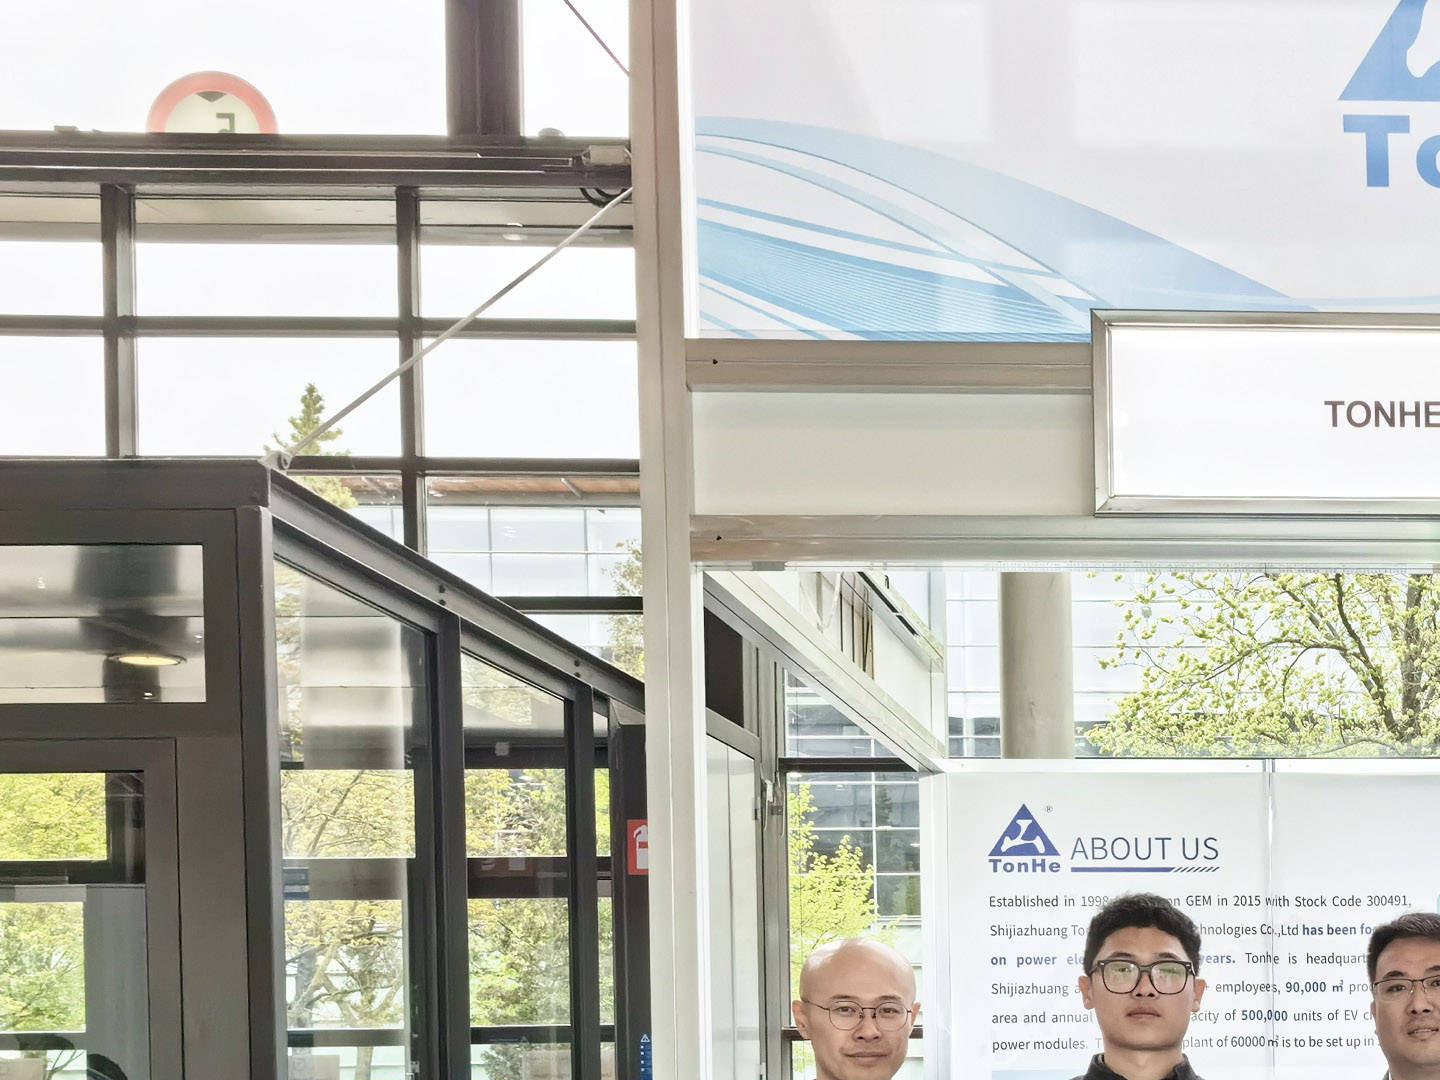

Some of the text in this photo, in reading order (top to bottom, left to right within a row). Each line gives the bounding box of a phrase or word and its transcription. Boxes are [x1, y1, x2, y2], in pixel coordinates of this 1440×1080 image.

[1071, 837, 1219, 860] ABOUT US
[988, 858, 1061, 873] TonHe
[989, 895, 1059, 907] Established
[1064, 895, 1075, 907] in
[1186, 895, 1212, 906] GEM
[1217, 895, 1228, 906] in
[1233, 895, 1261, 906] 2015
[1265, 895, 1290, 907] with
[1294, 895, 1327, 907] Stock
[1332, 895, 1362, 907] Code
[1366, 895, 1412, 908] 300491,
[990, 924, 1068, 939] Shijiazhuang
[1196, 923, 1257, 938] hnologies
[1302, 923, 1323, 935] has
[1327, 923, 1357, 935] been
[990, 955, 1007, 965] on
[1016, 955, 1057, 968] power
[1245, 952, 1280, 964] Tonhe
[1288, 953, 1297, 964] is
[1306, 952, 1369, 967] headquart
[991, 983, 1069, 998] Shijiazhuang
[1215, 981, 1281, 995] employees,
[1285, 981, 1326, 995] 90,000
[992, 1013, 1018, 1023] area
[1023, 1012, 1046, 1023] and
[1051, 1011, 1093, 1023] annual
[1191, 1010, 1219, 1023] acity
[1224, 1009, 1236, 1021] of
[1241, 1010, 1288, 1023] 500,000
[1293, 1009, 1322, 1021] units
[1327, 1009, 1339, 1021] of
[1344, 1010, 1358, 1020] EV
[992, 1041, 1030, 1053] power
[1033, 1038, 1088, 1050] modules.
[1182, 1035, 1214, 1049] plant
[1216, 1035, 1229, 1048] of
[1282, 1036, 1291, 1048] is
[1294, 1037, 1305, 1048] to
[1309, 1035, 1323, 1048] be
[1326, 1036, 1343, 1047] set
[1346, 1038, 1361, 1050] up
[1363, 1035, 1374, 1047] in
